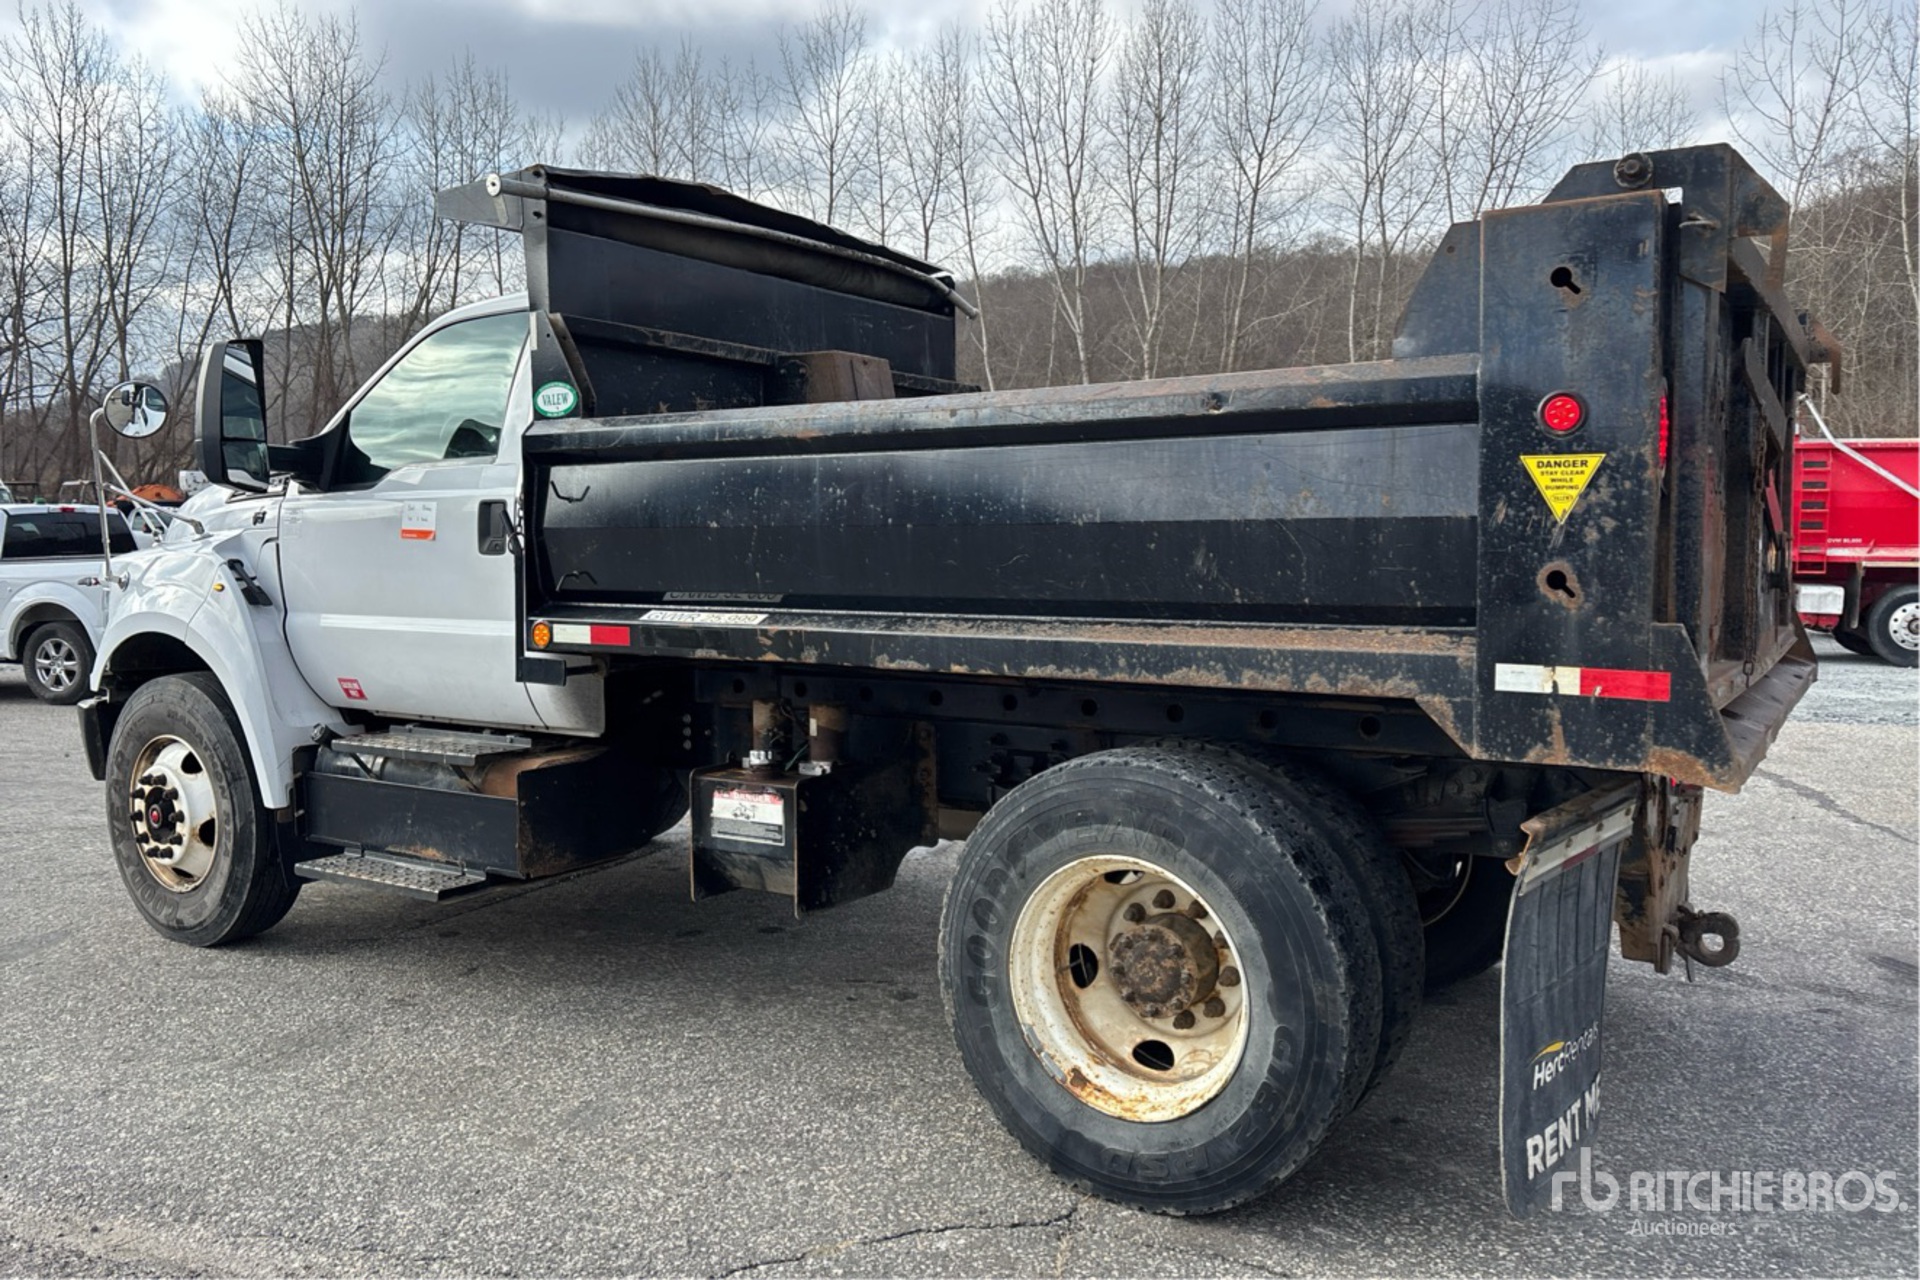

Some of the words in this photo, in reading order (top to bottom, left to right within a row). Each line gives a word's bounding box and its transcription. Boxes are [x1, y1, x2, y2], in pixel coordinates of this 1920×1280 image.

[541, 392, 569, 406] VALEW
[1536, 459, 1589, 469] DANGER
[1526, 1098, 1581, 1181] RENT
